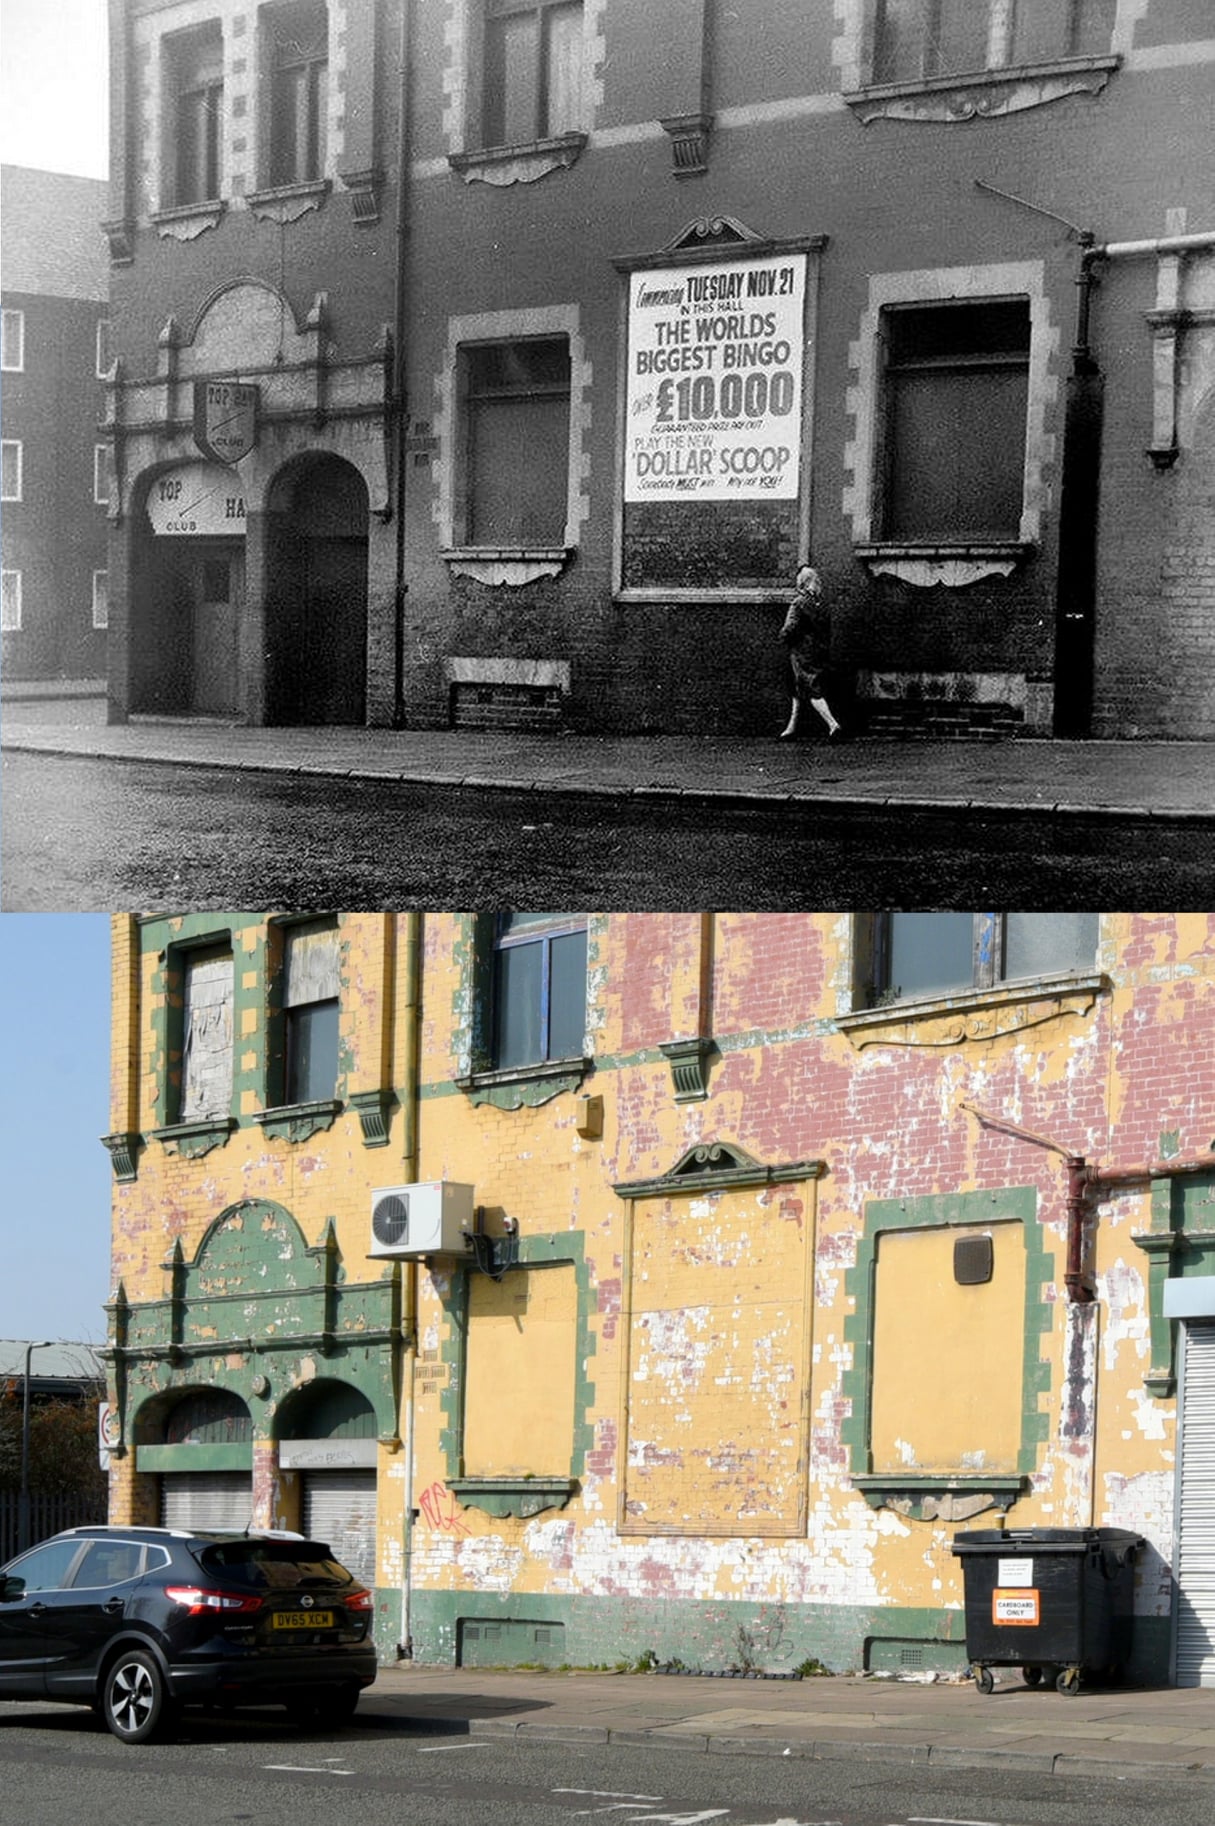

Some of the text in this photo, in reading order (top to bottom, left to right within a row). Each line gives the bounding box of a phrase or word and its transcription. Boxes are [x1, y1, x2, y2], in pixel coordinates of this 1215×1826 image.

[687, 273, 745, 303] TUESDAY
[694, 303, 714, 314] THIS
[717, 302, 744, 312] HALL
[655, 313, 776, 345] THE WORLDS
[636, 340, 790, 375] BIGGEST BINGO
[656, 371, 794, 422] £10,000
[635, 434, 714, 450] PLAY THE NEW
[719, 446, 790, 474] SCOOP
[160, 481, 182, 501] TOP
[166, 521, 197, 532] CLUB
[277, 1613, 329, 1626] DV65 XCM
